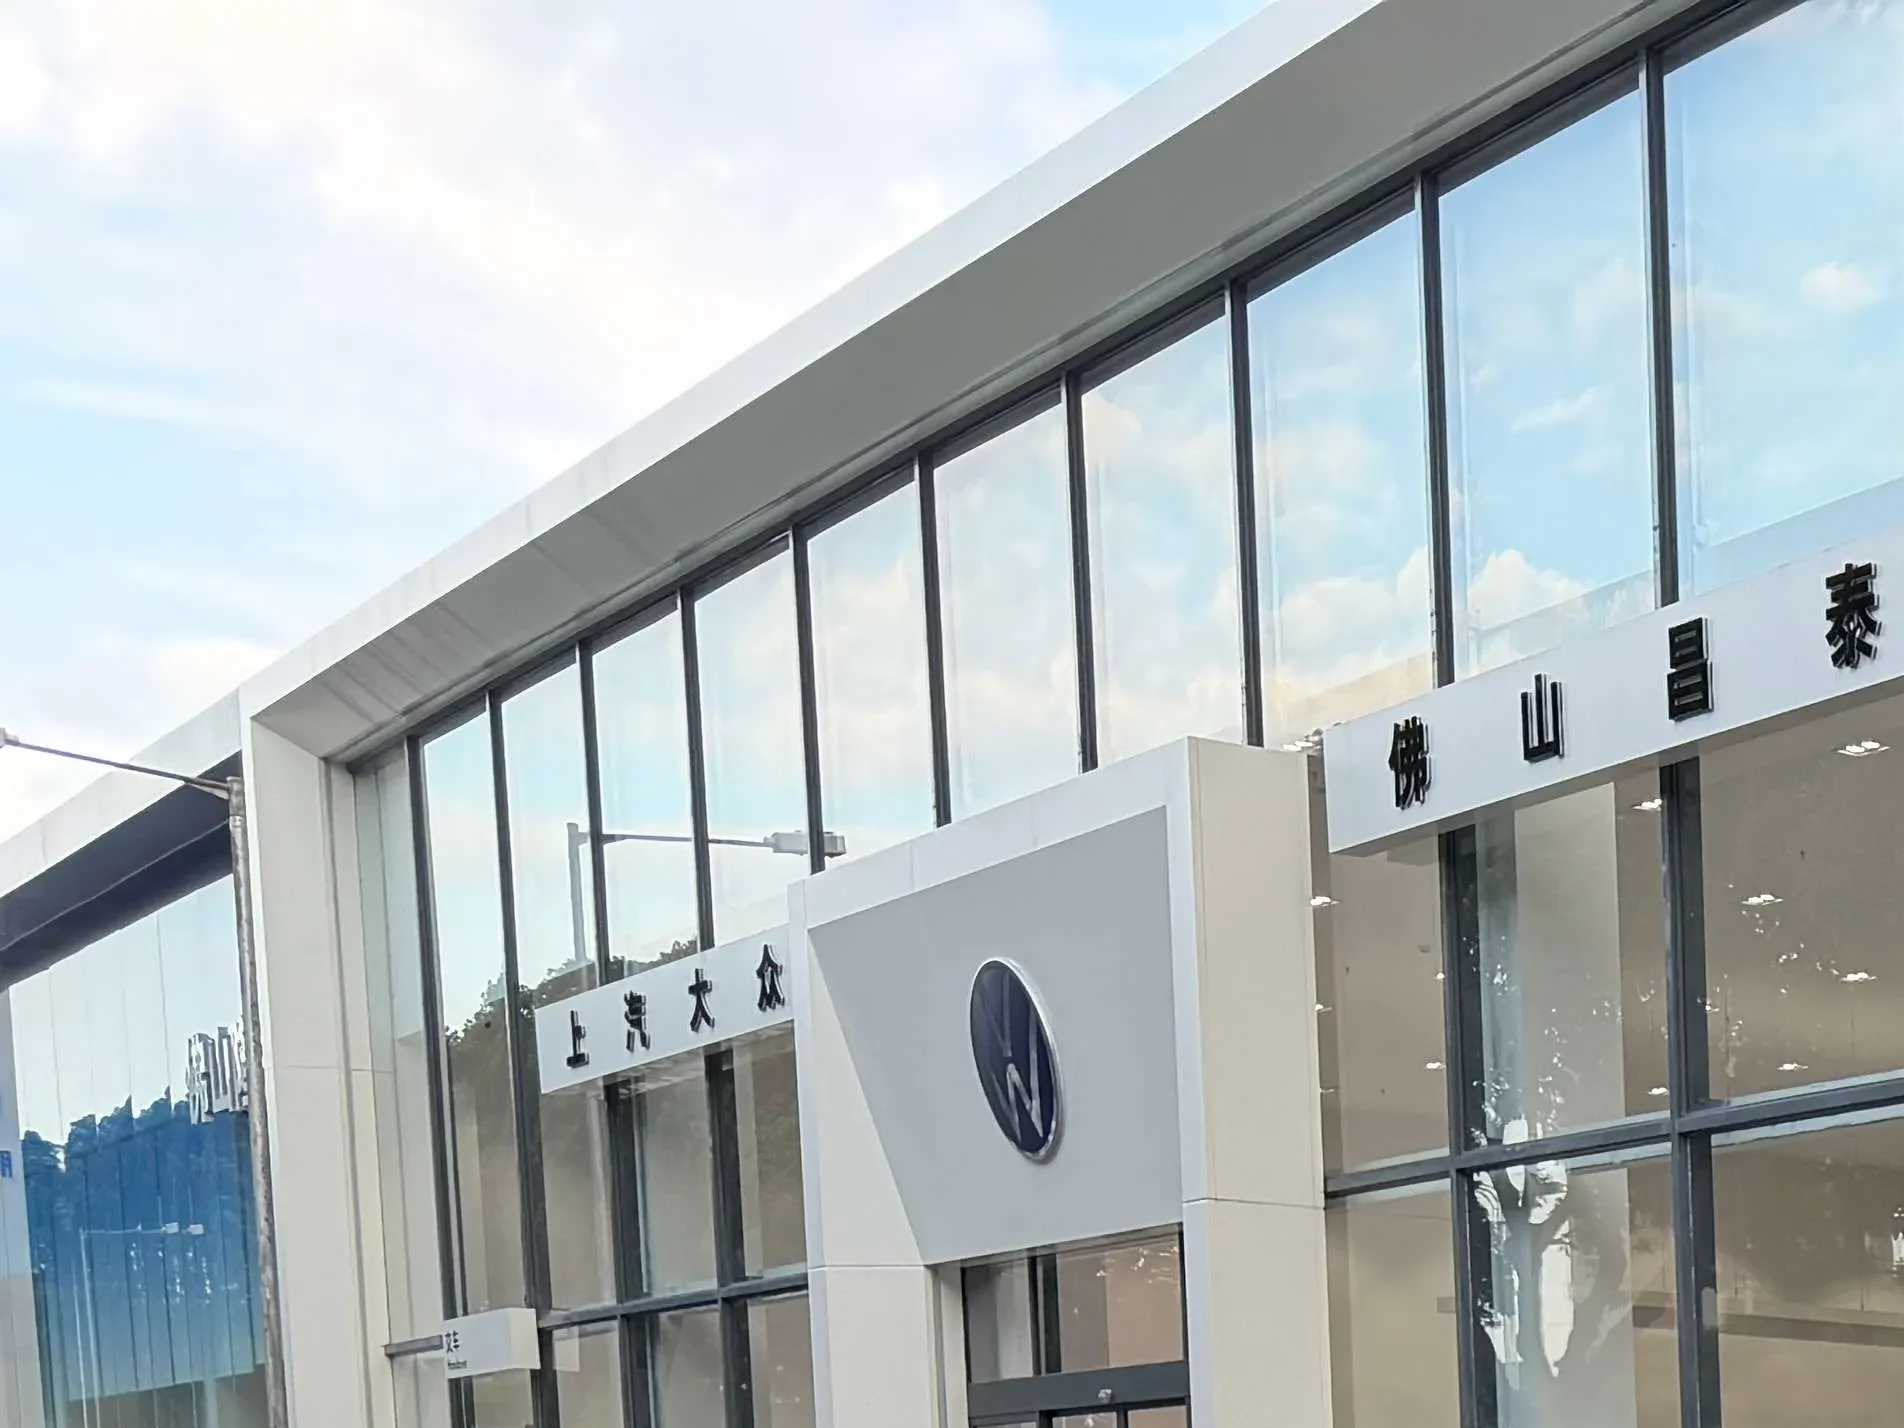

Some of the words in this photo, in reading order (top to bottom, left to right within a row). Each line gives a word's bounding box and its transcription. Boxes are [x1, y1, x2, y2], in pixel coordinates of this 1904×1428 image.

[1387, 562, 1882, 811] 佛山昌泰
[566, 944, 786, 1068] 上汽大众
